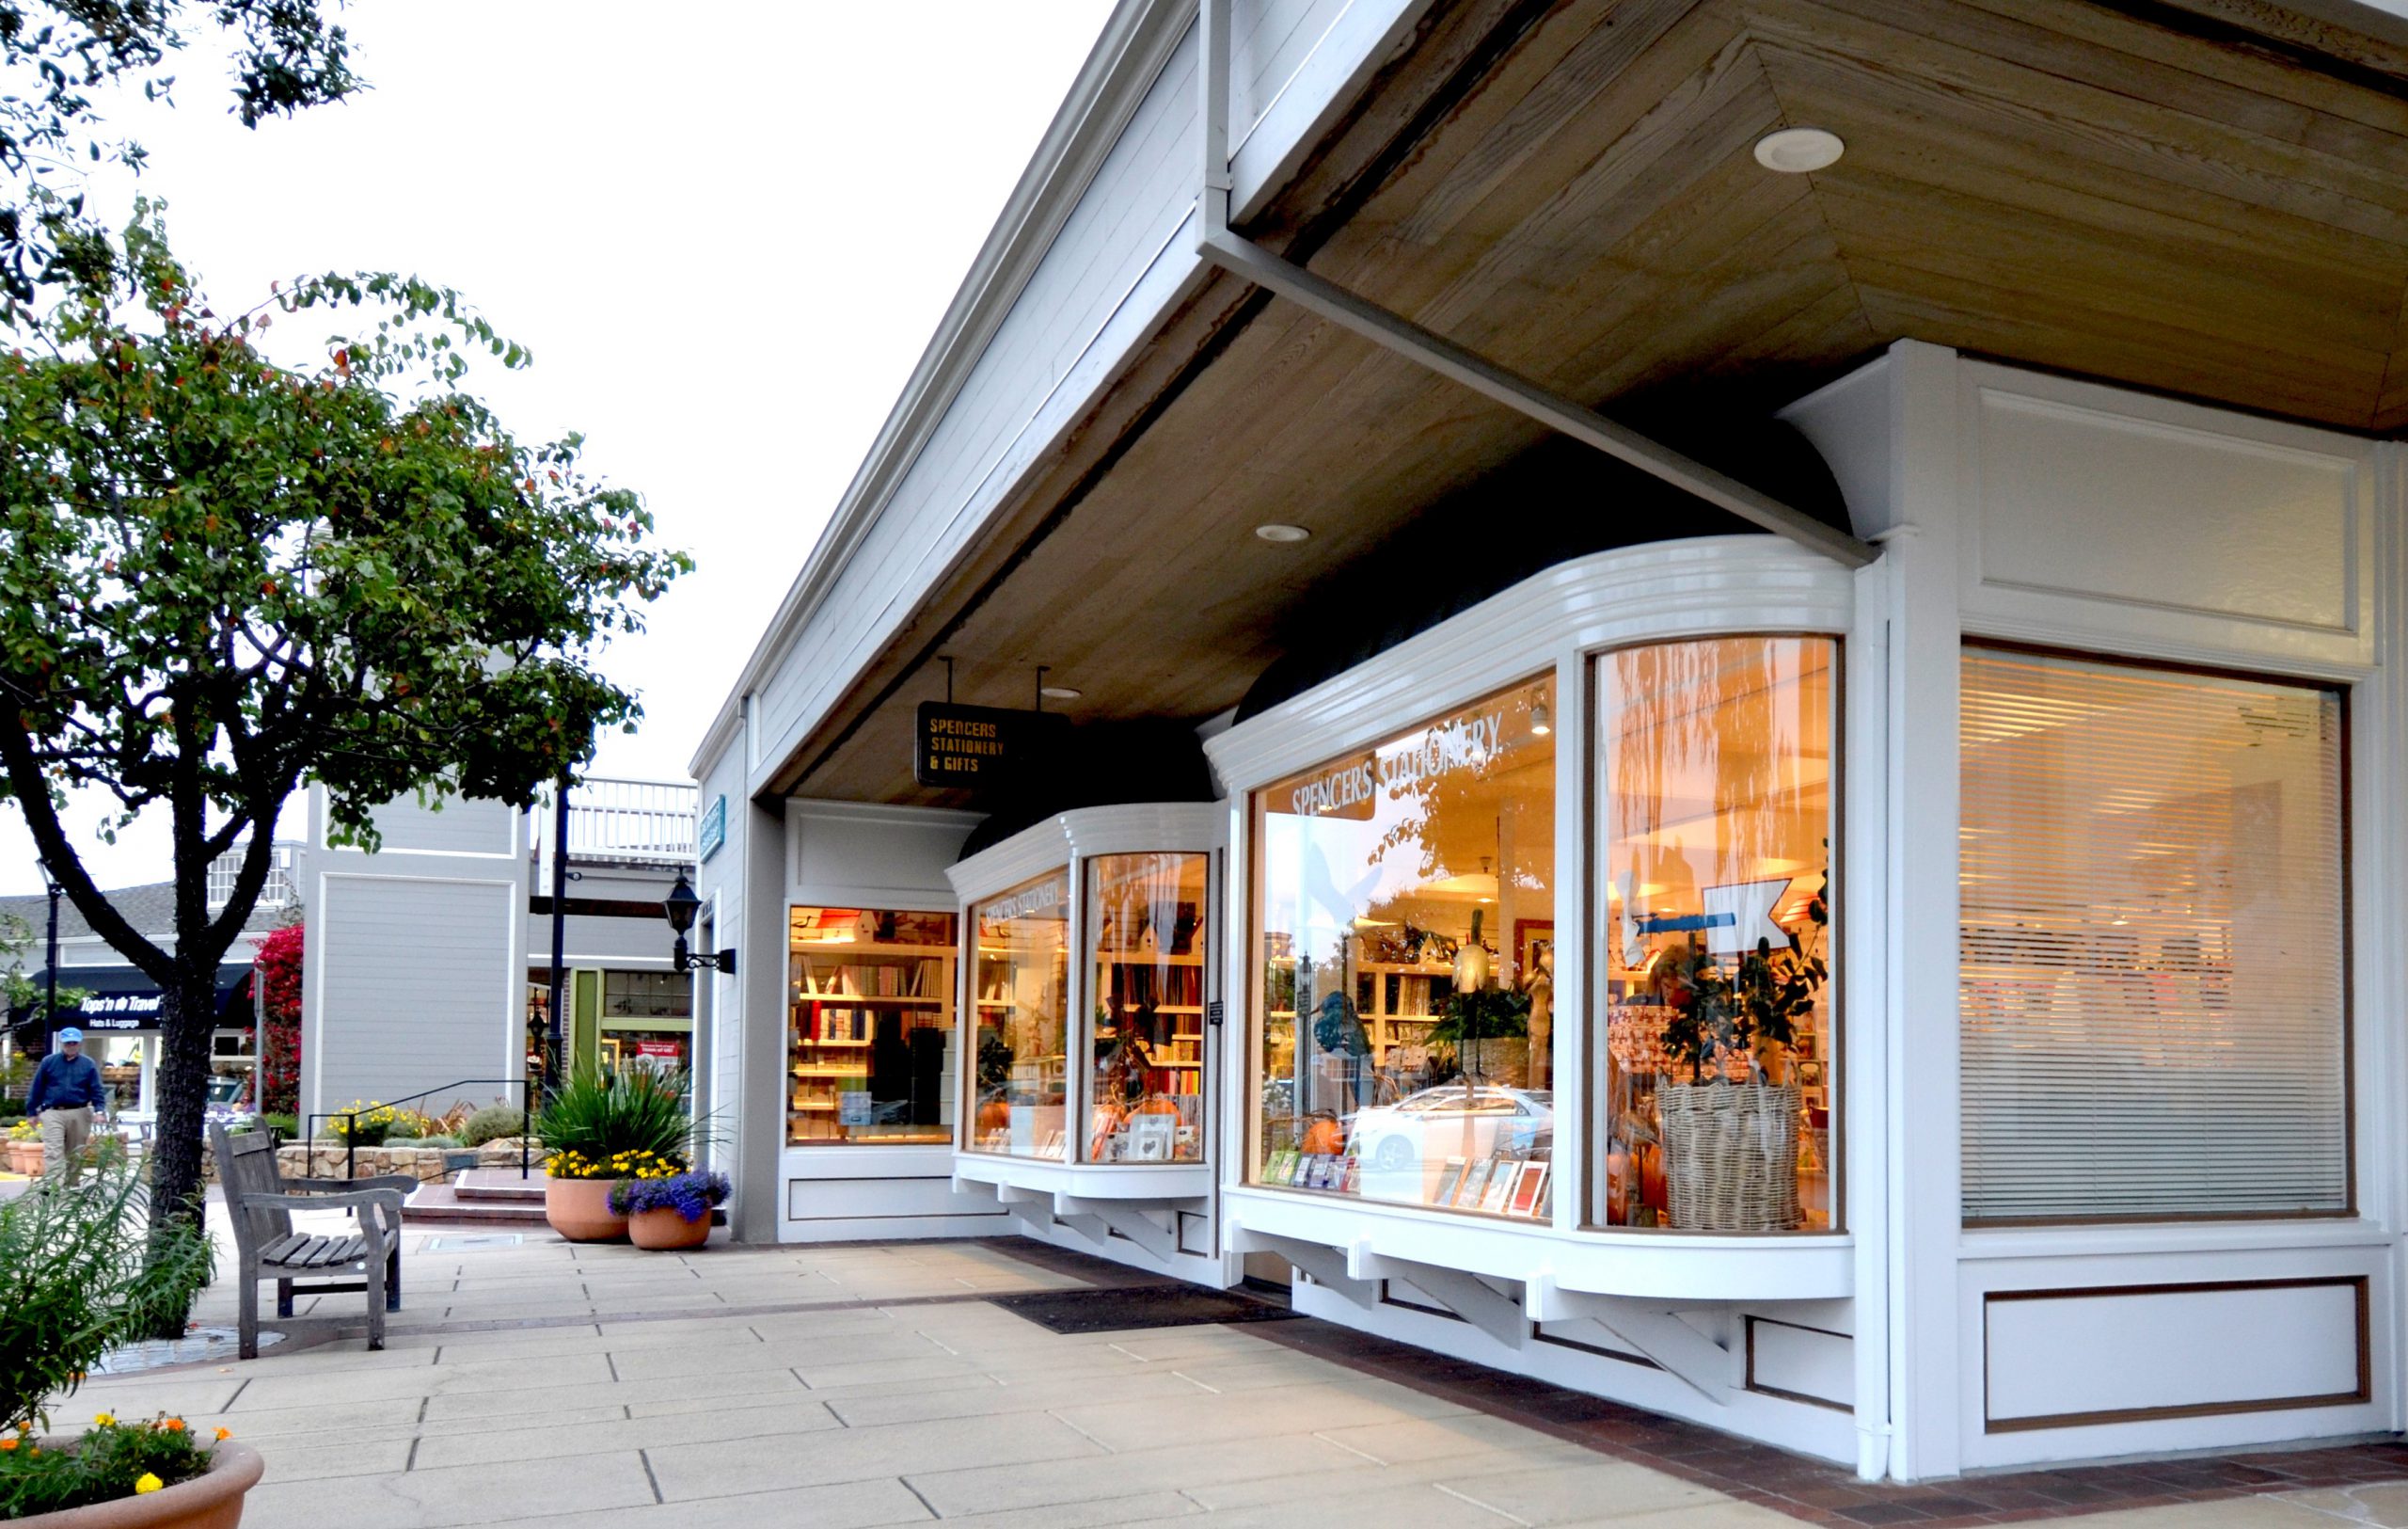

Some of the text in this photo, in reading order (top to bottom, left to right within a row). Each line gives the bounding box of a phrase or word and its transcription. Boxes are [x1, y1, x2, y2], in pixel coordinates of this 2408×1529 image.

[930, 718, 996, 738] SPENCERS
[931, 737, 1004, 756] STATIONERY
[944, 757, 978, 772] GIFTS
[1291, 712, 1503, 817] SPENCERS STATIONERY
[128, 995, 161, 1011] Travel
[111, 1019, 139, 1028] Luggage
